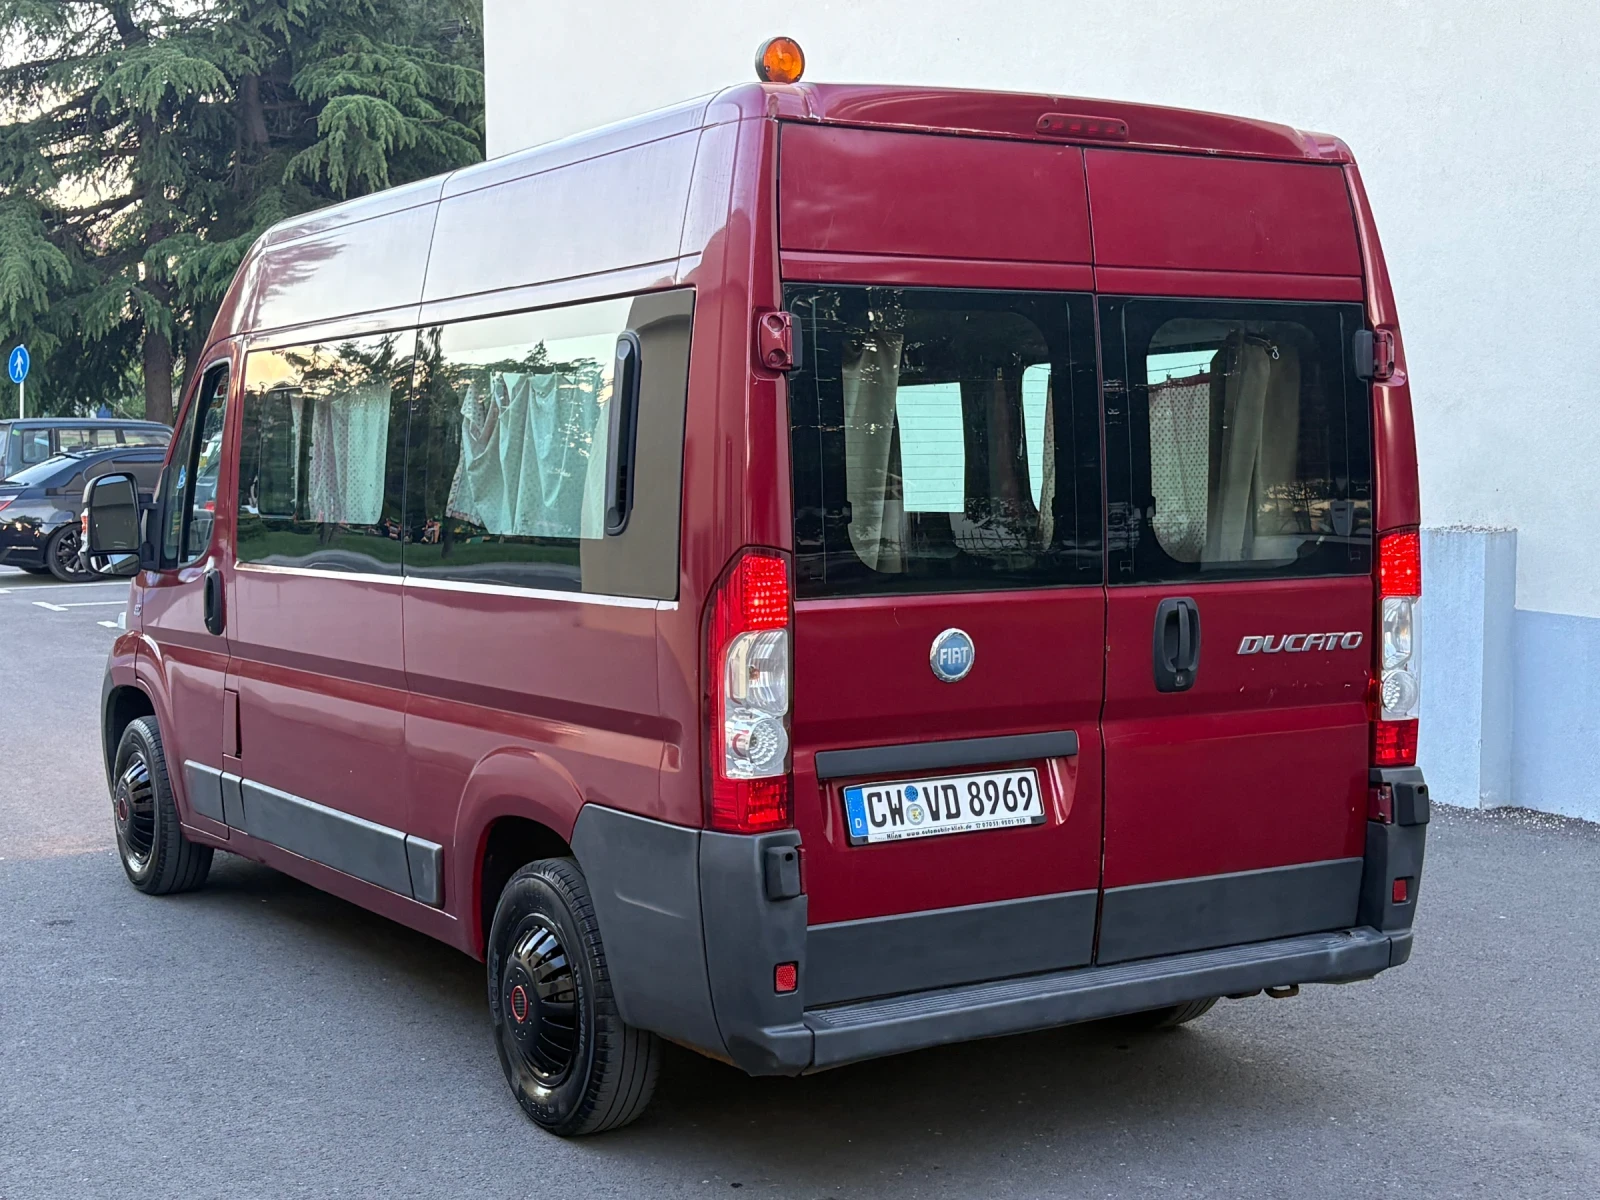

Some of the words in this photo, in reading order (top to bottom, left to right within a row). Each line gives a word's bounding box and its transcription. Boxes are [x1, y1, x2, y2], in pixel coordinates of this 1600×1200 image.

[1236, 631, 1364, 655] DUCATO
[939, 646, 969, 666] FIAT
[866, 789, 905, 828] CW
[922, 784, 962, 822] VD
[967, 776, 1033, 817] 8969
[854, 817, 862, 829] D
